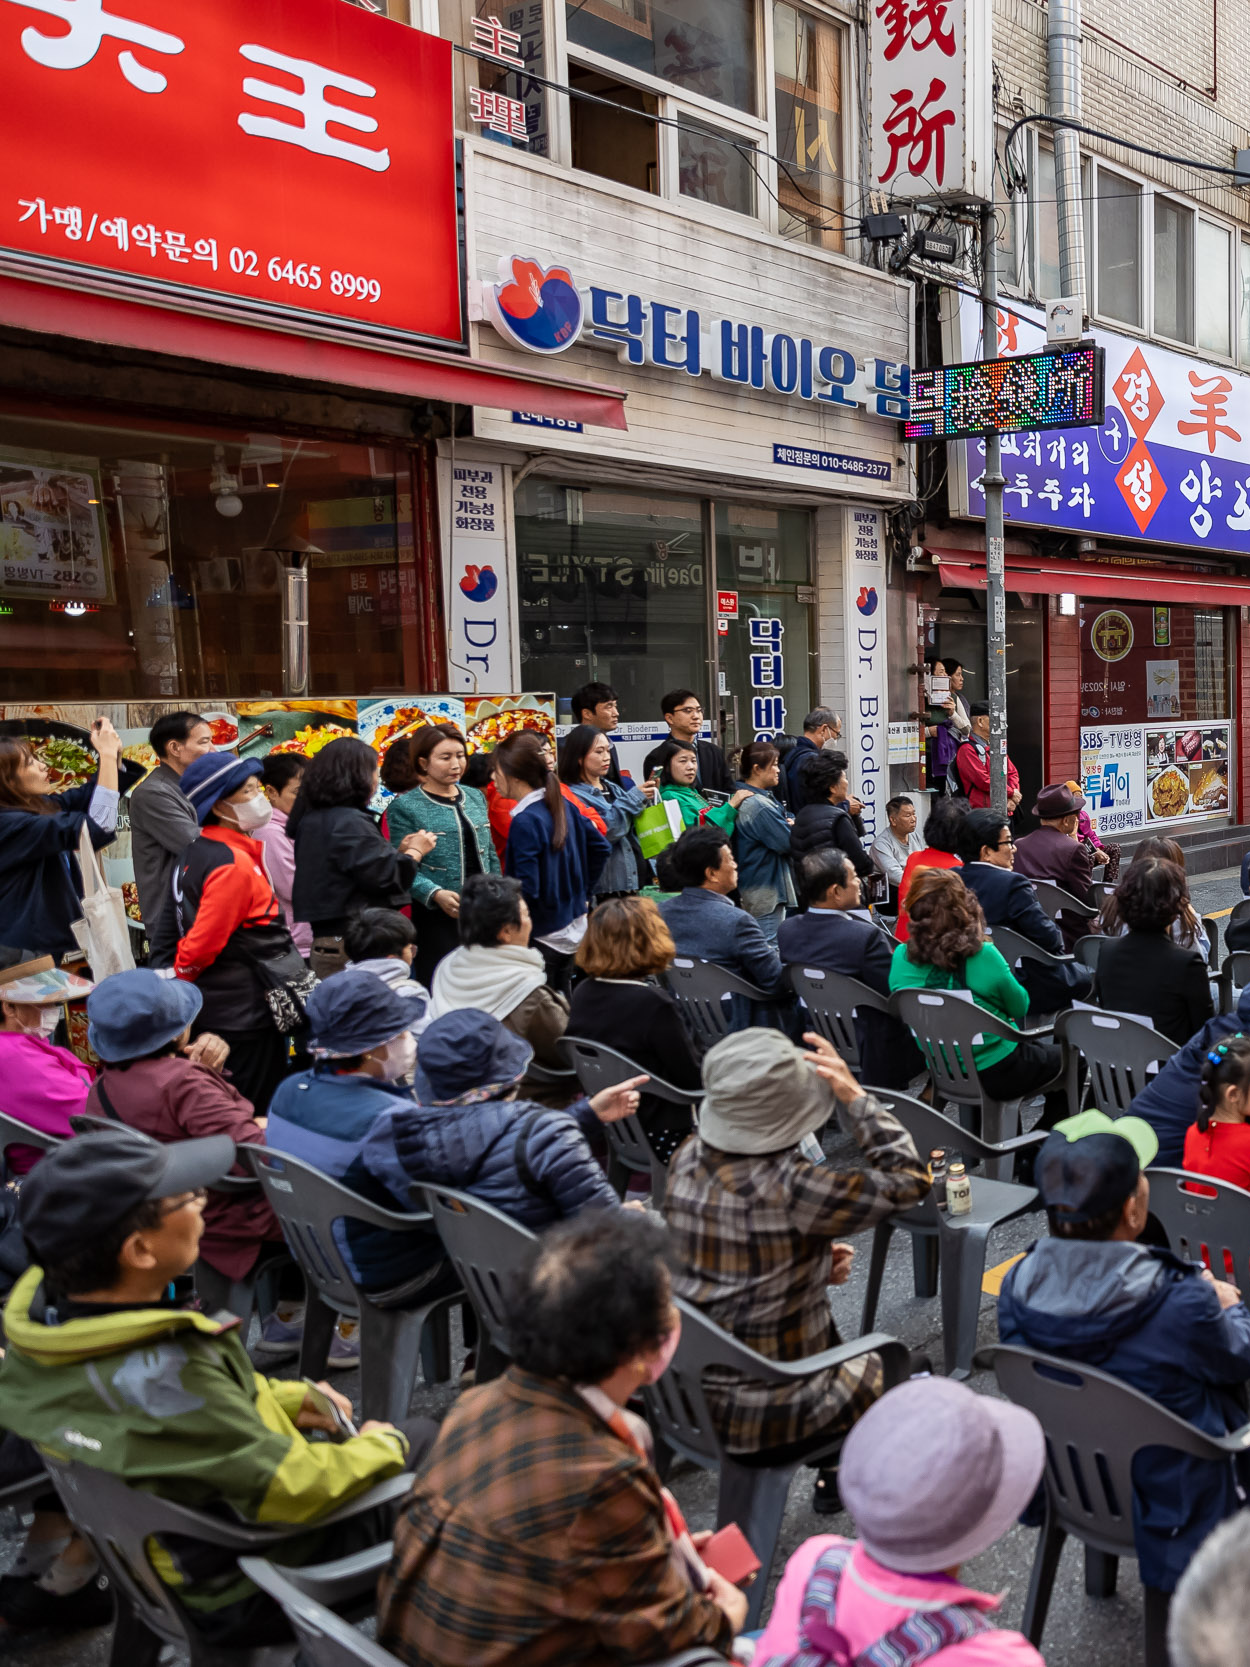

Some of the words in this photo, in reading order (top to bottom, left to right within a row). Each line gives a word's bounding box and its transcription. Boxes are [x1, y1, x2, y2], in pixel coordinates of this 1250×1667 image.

[18, 198, 219, 272] 가맹/예약문의
[229, 247, 260, 278] 02
[267, 261, 322, 291] 6465
[330, 270, 382, 304] 8999
[590, 286, 701, 377] 닥터
[720, 319, 859, 409] 바이오
[454, 467, 493, 485] 피부과
[821, 455, 889, 478] 010-6486-2377
[460, 484, 487, 500] 전용
[455, 500, 495, 517] 기능성
[454, 516, 495, 532] 화장품
[464, 617, 497, 683] Dr.
[750, 619, 784, 688] 닥터
[857, 627, 878, 679] Dr.
[1082, 729, 1142, 750] SBS-TV방영
